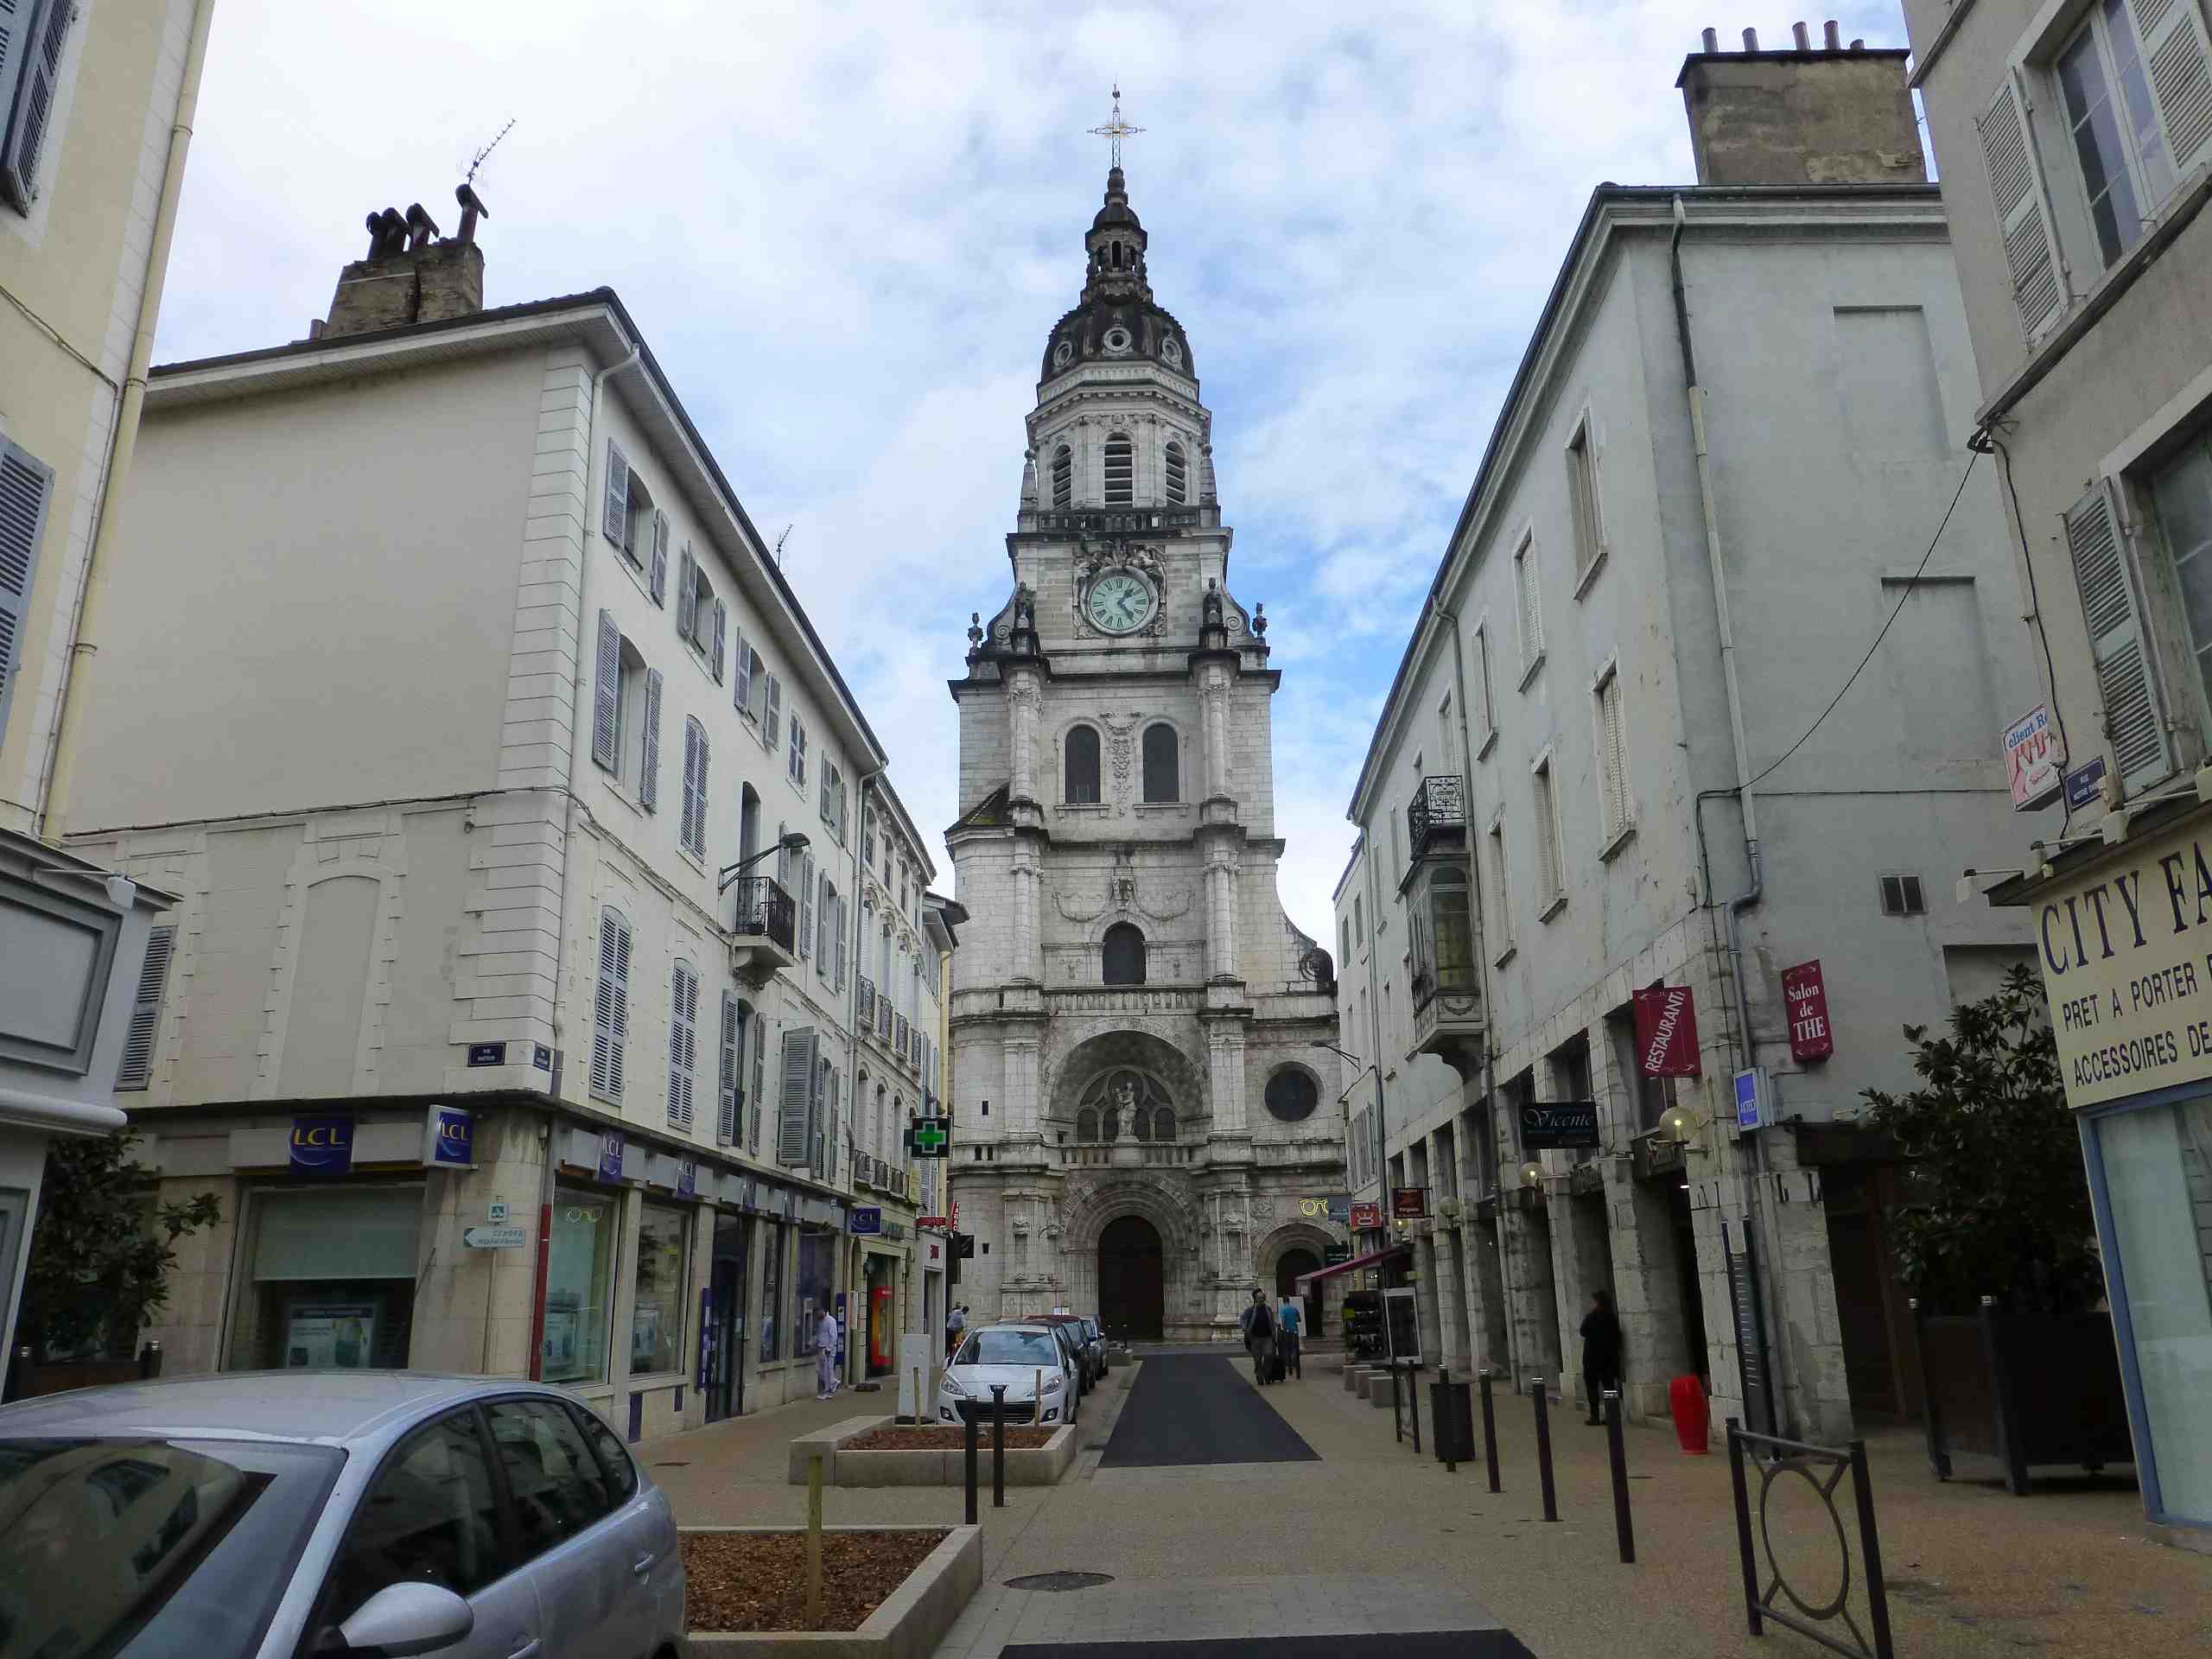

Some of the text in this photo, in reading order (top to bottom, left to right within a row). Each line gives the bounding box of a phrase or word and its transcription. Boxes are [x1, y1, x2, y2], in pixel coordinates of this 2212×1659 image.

[2041, 870, 2147, 975] CITY
[1788, 983, 1819, 1002] Salon
[2062, 994, 2100, 1032] PRET
[2112, 988, 2123, 1019] A
[2131, 962, 2198, 1012] PORTER
[1799, 1002, 1814, 1017] de
[1644, 991, 1686, 1072] RESTAURANT
[1793, 1015, 1826, 1042] THE
[2074, 1031, 2178, 1087] ACCESSOIRES
[294, 1127, 346, 1147] LCL
[442, 1121, 469, 1141] LCL
